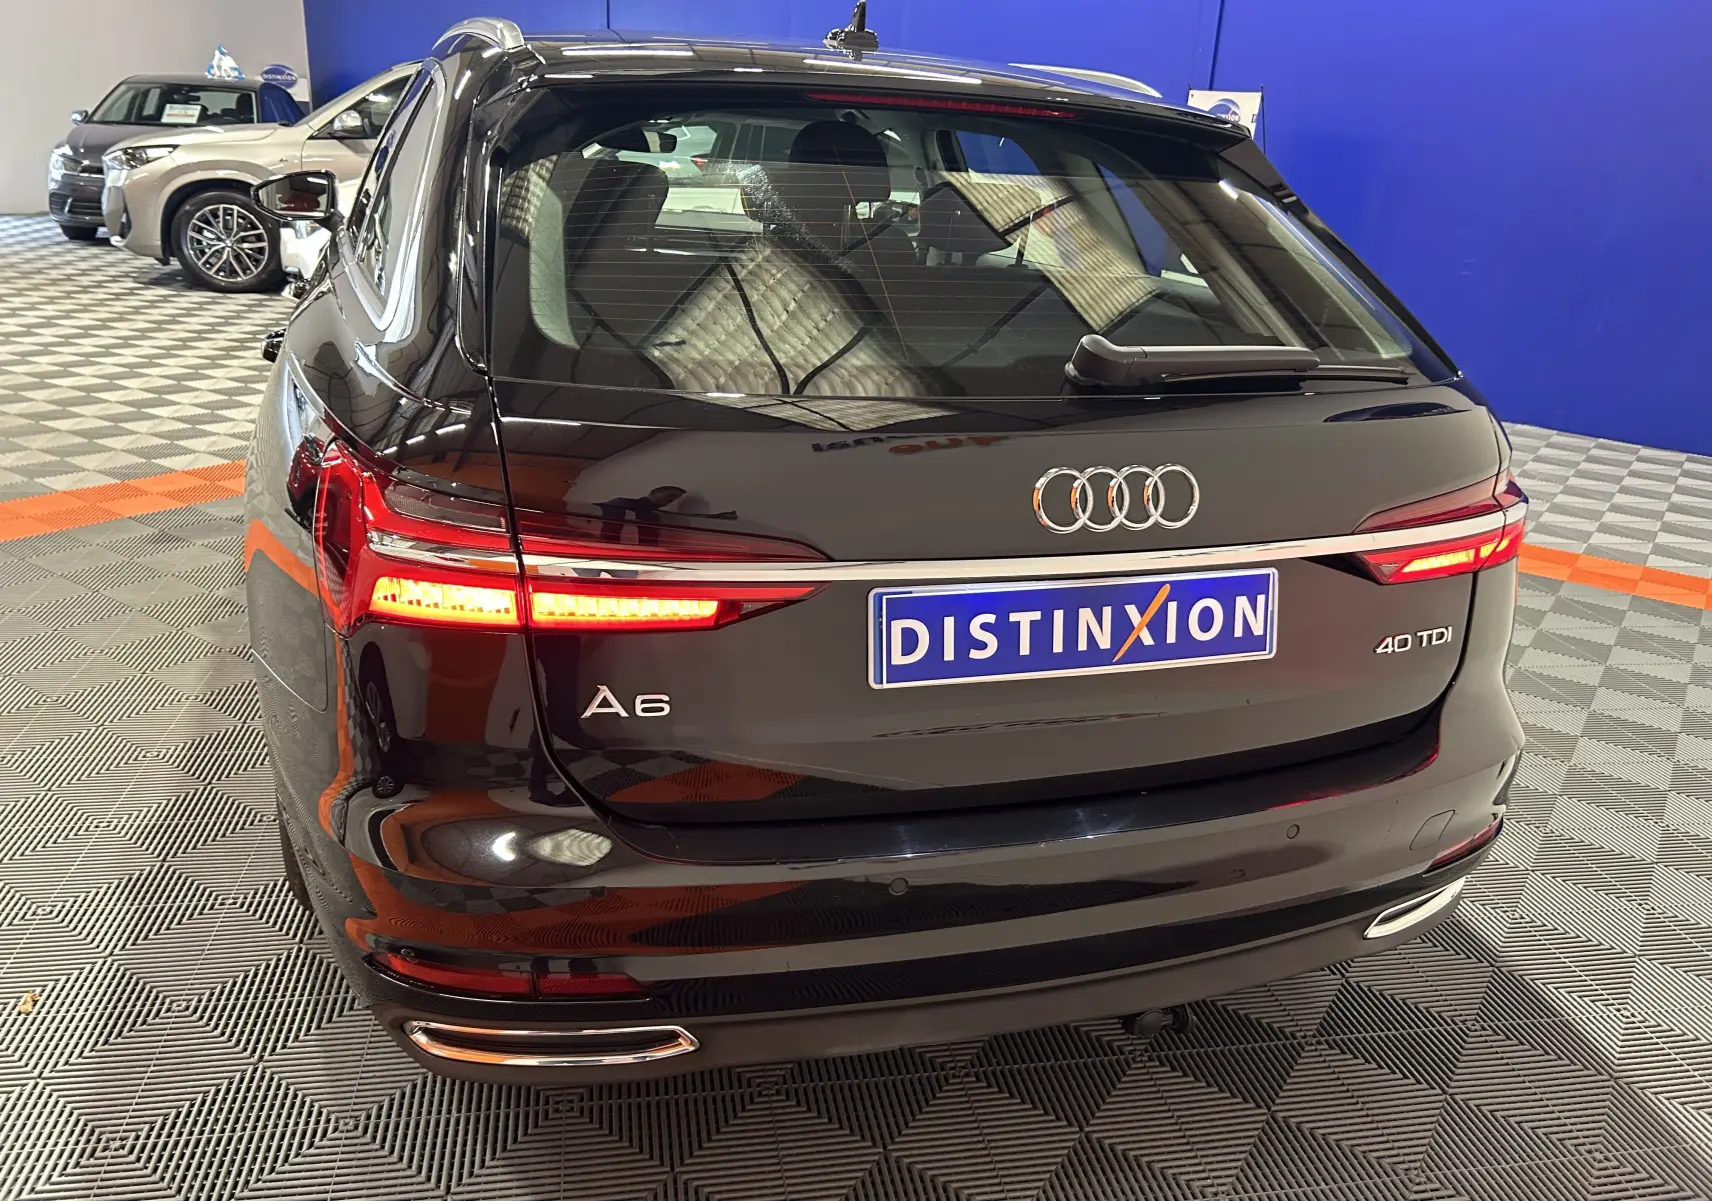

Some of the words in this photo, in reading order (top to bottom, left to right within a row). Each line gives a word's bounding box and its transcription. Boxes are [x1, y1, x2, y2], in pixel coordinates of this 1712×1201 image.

[890, 583, 1267, 665] DISTINXION
[1375, 634, 1412, 654] 40
[1416, 626, 1453, 647] TDI
[580, 684, 671, 719] A6
